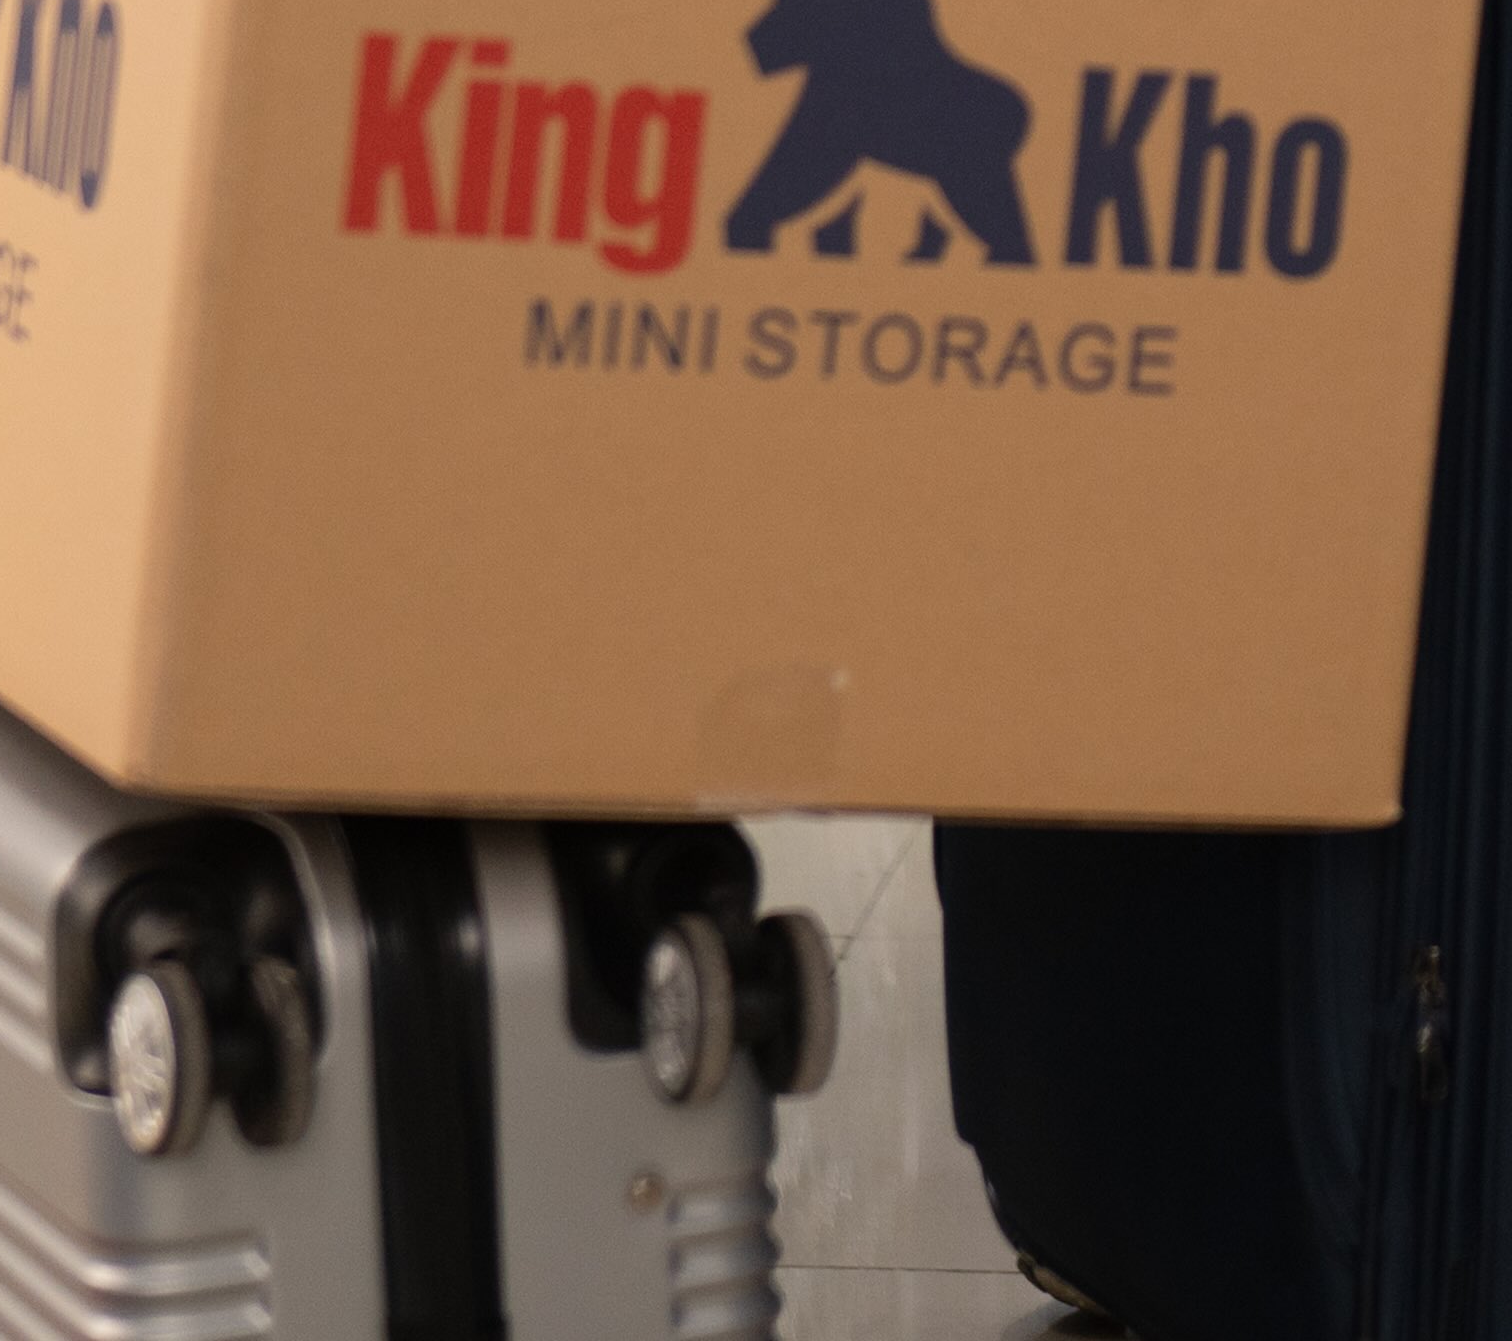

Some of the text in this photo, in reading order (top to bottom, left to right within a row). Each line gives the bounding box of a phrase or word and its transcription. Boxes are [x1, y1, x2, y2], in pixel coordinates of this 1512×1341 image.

[340, 30, 1350, 280] King Kho
[524, 297, 1180, 397] MINI STORAGE
